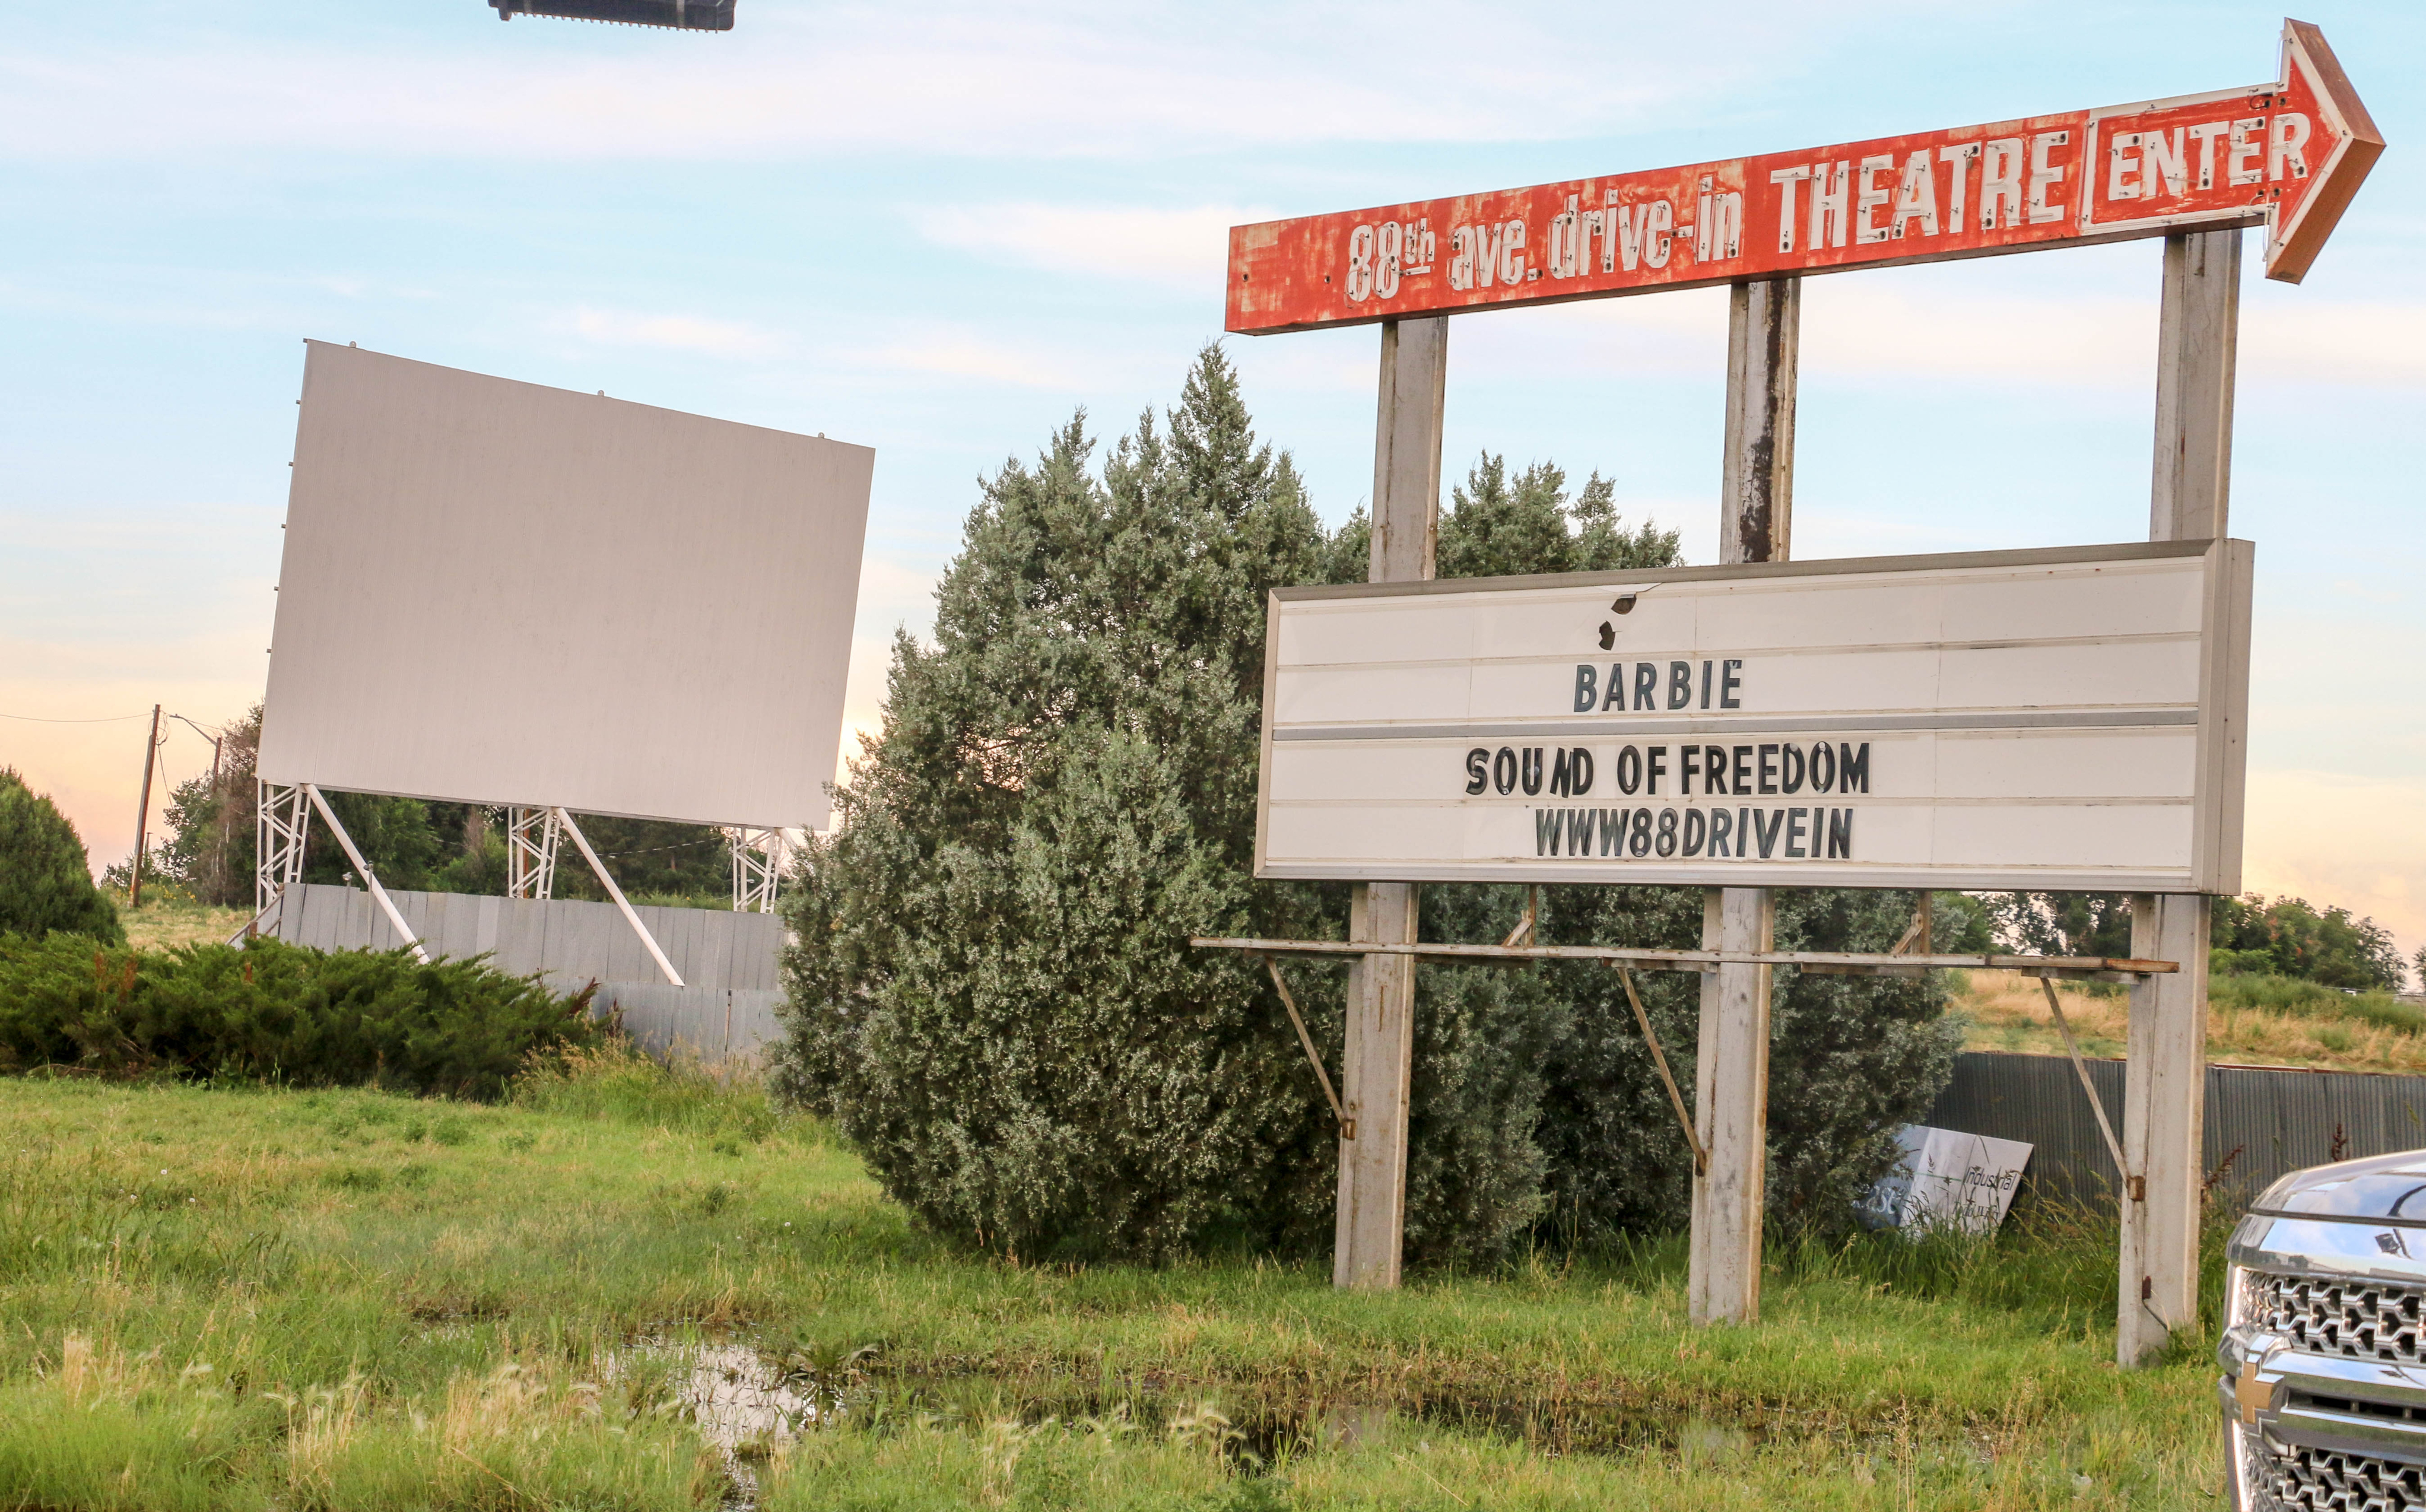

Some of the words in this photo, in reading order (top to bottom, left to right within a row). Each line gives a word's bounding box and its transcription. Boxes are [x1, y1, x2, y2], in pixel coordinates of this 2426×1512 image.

[2108, 112, 2311, 201] ENTER
[1347, 218, 1436, 302] 88th
[1450, 220, 1538, 291] ave.
[1549, 176, 1742, 279] drive-in
[1770, 129, 2069, 254] THEATRE
[1574, 660, 1742, 712] BARBIE
[1465, 747, 1593, 798] SOUND
[1617, 745, 1666, 795] OF
[1681, 741, 1869, 795] FREEDOM
[1535, 808, 1853, 859] WWW88DRIVEIN
